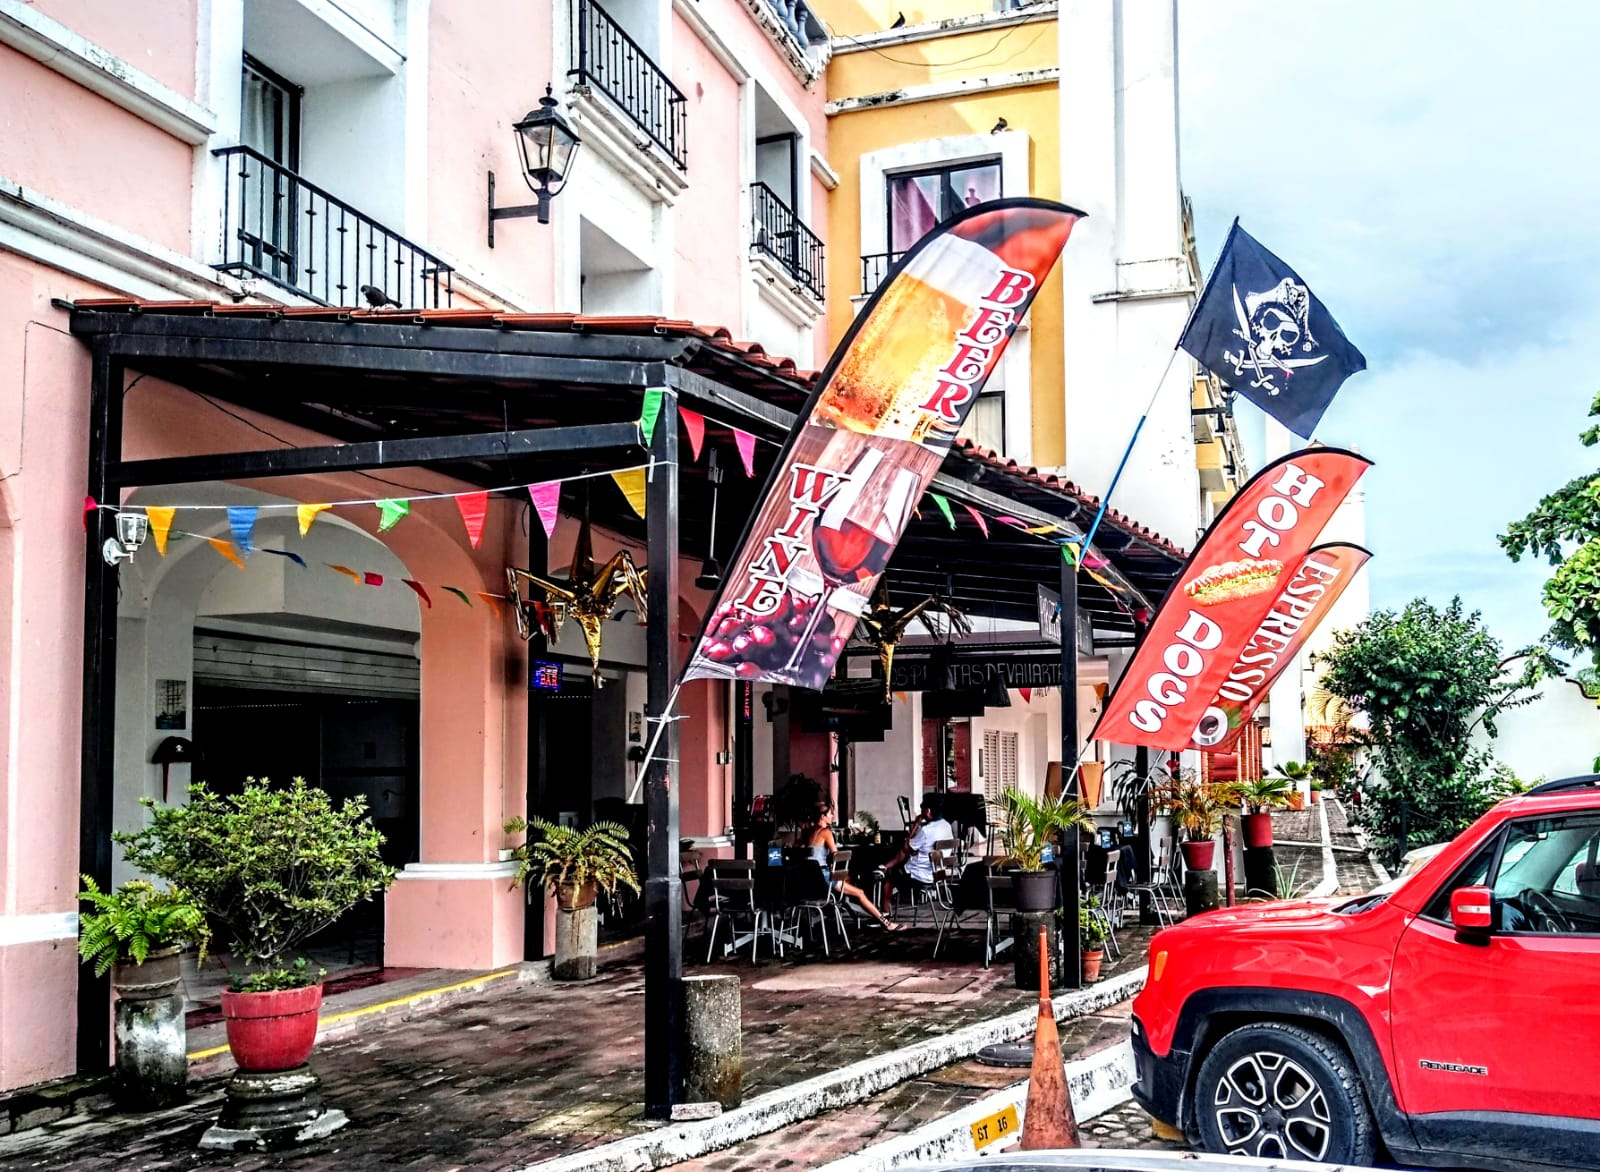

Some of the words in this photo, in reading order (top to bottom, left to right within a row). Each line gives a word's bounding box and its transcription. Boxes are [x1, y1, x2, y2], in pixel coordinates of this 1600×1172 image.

[916, 267, 1036, 423] BEER
[734, 463, 852, 616] WINE
[1238, 463, 1325, 558] HOT
[1128, 609, 1223, 733] DOGS
[1218, 557, 1341, 701] ESPRESSO
[977, 1124, 989, 1142] ST
[997, 1116, 1008, 1133] 16
[1419, 1060, 1487, 1076] RENEGADE
